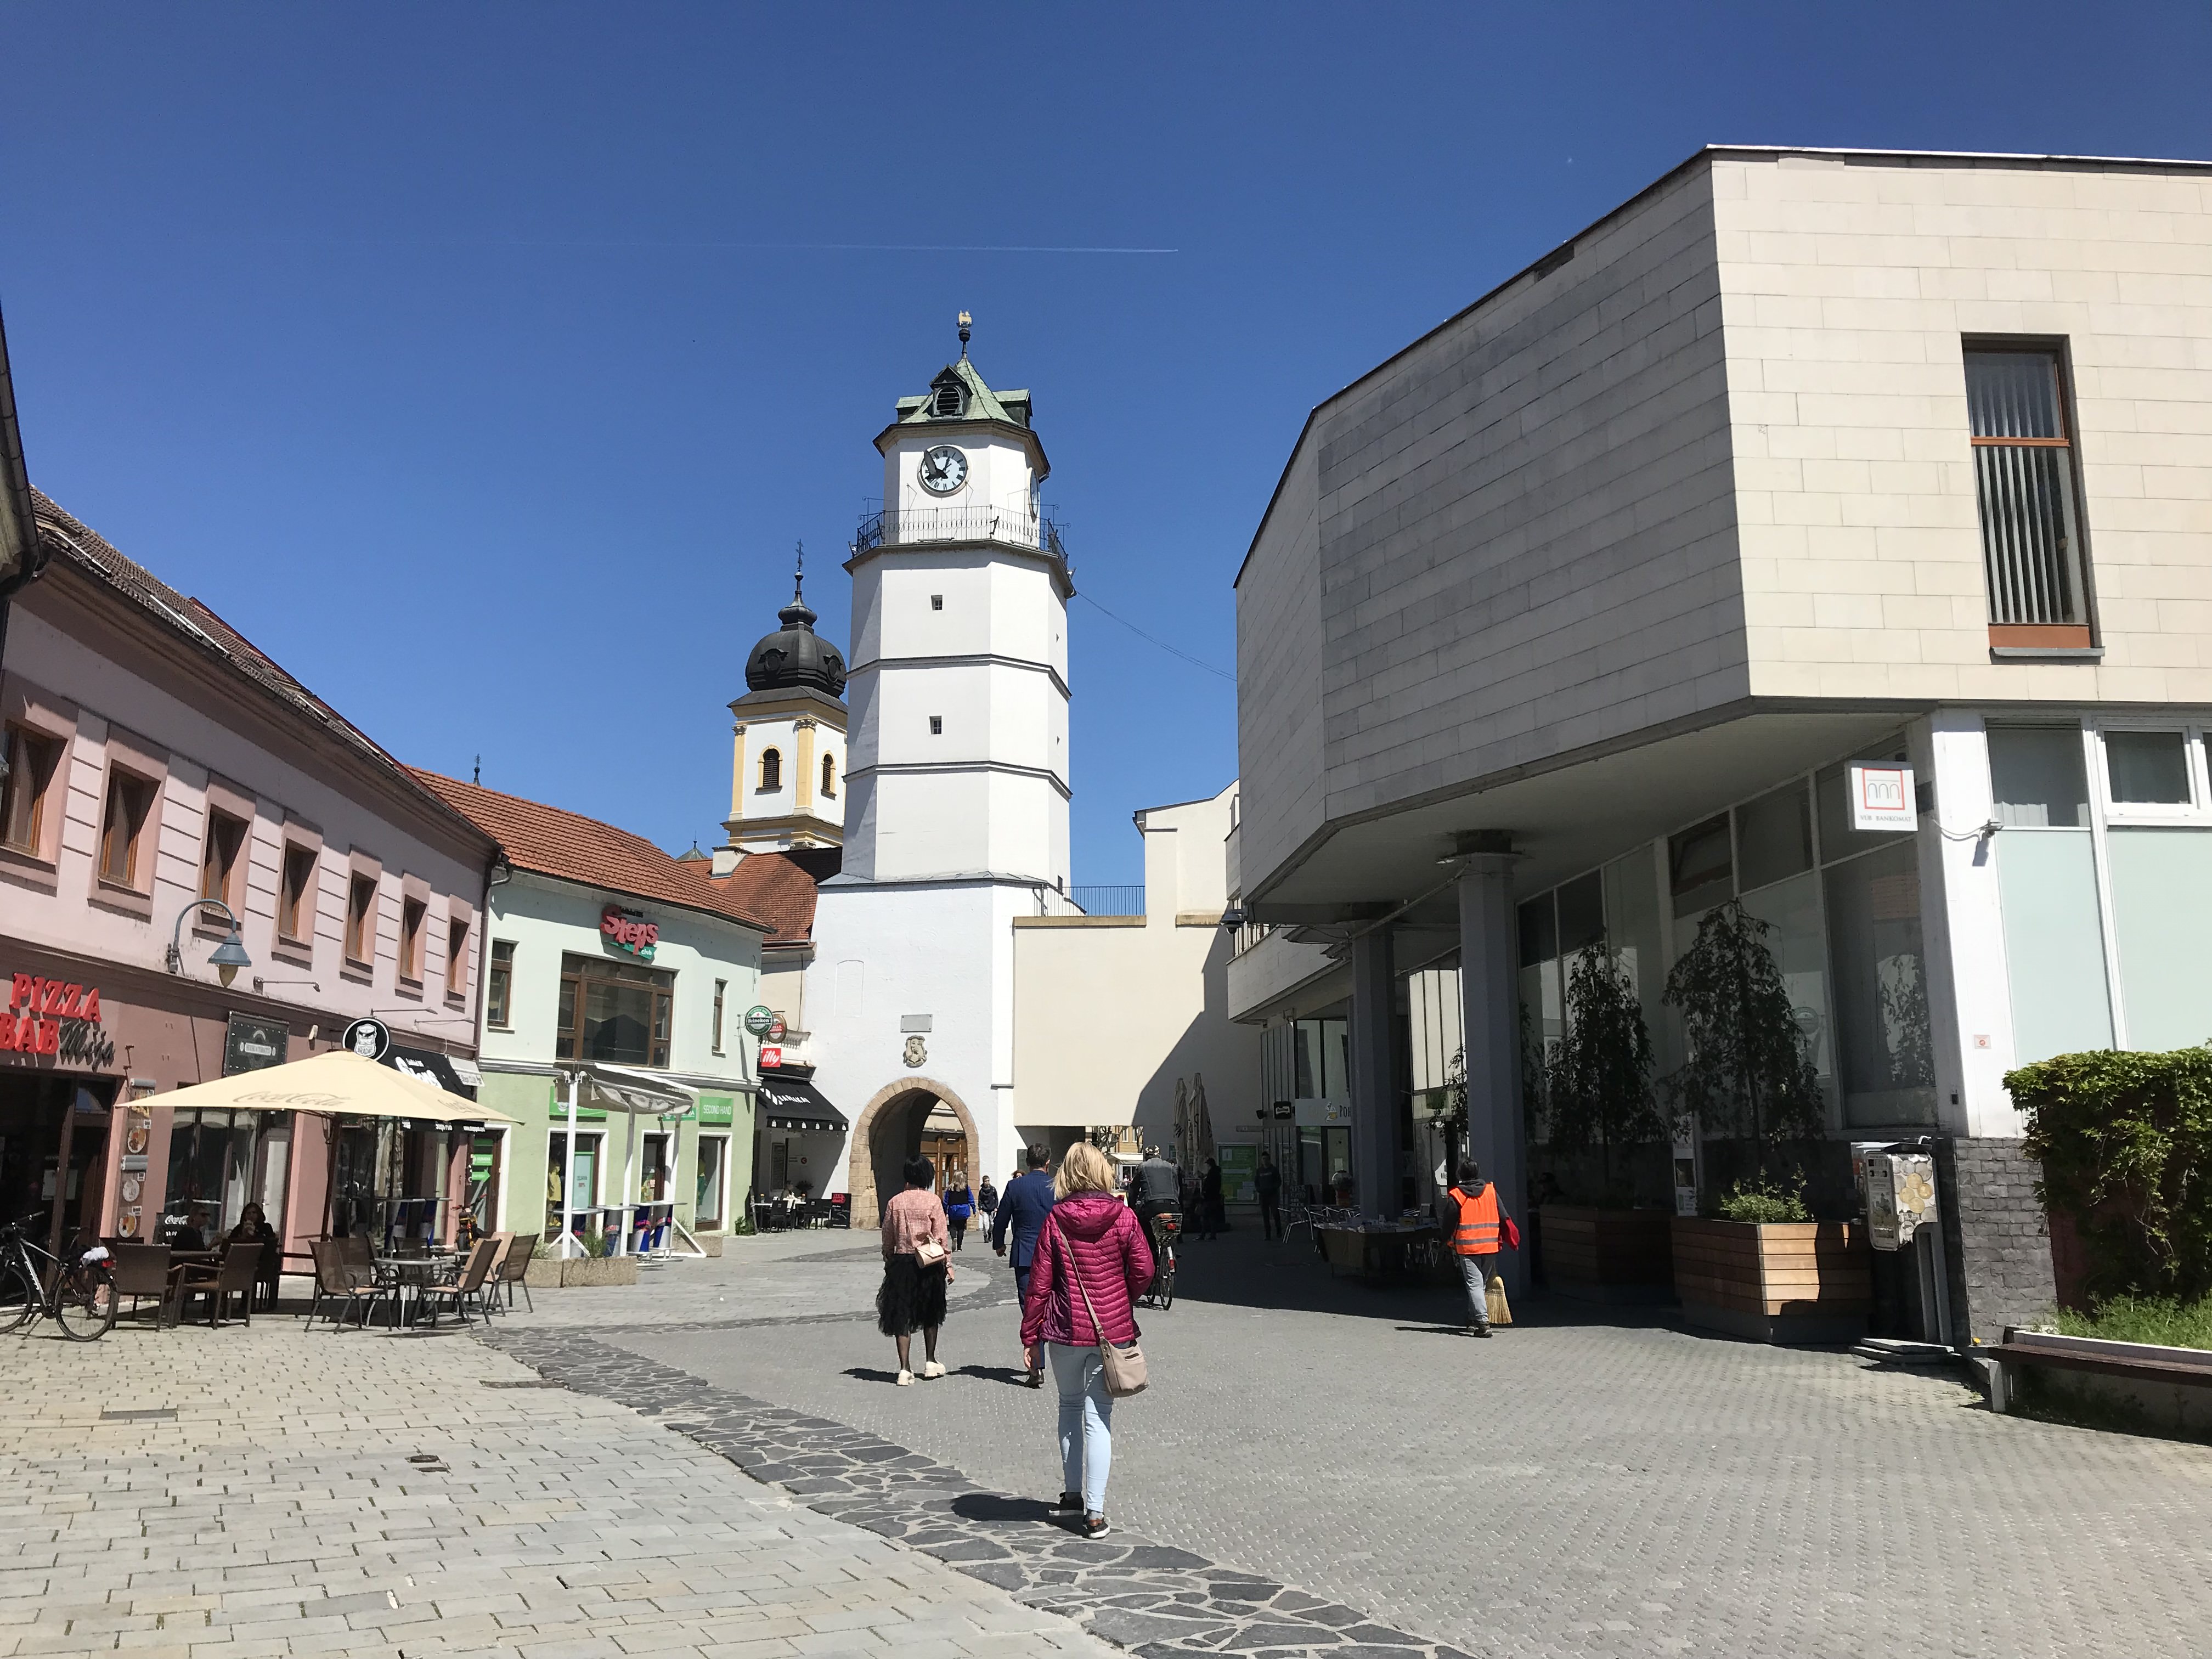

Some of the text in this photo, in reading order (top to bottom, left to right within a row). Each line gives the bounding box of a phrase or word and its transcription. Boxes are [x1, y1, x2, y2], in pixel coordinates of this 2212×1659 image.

[600, 904, 659, 956] Steps
[9, 973, 102, 1023] PIZZA
[763, 1050, 780, 1066] illy
[703, 1104, 732, 1115] SECOND HAND
